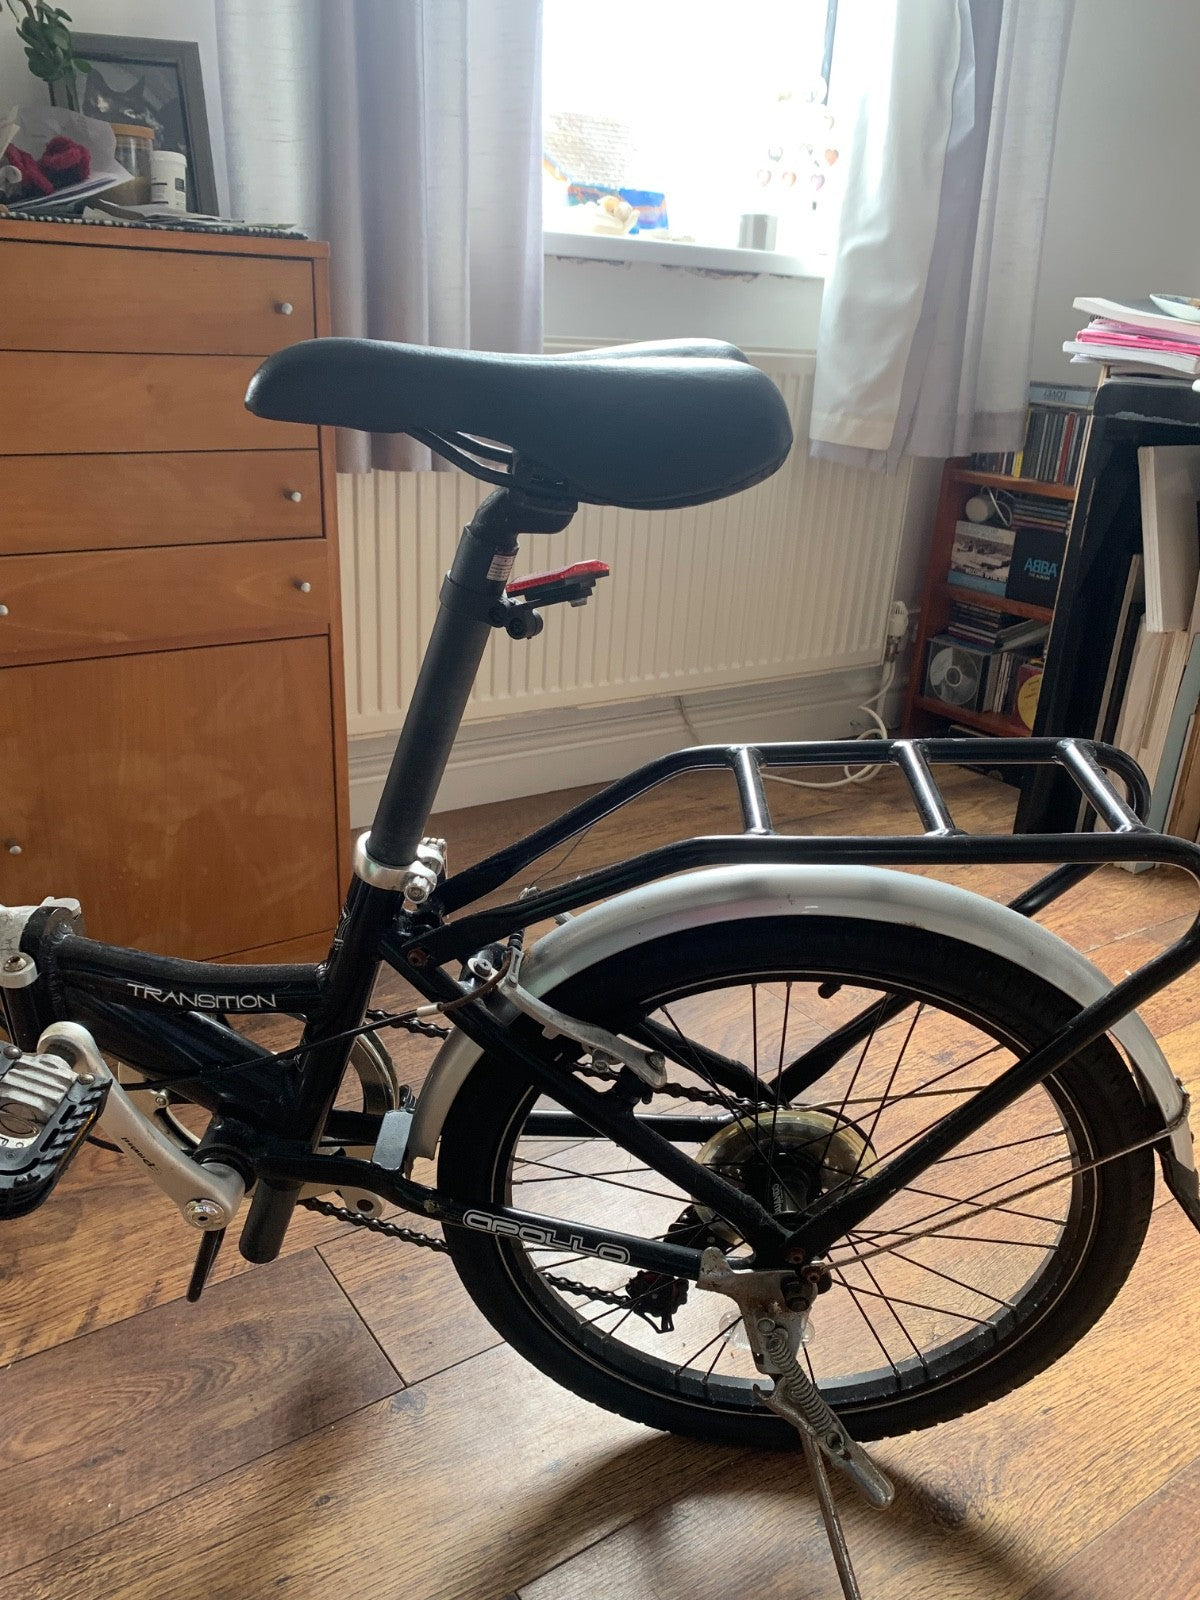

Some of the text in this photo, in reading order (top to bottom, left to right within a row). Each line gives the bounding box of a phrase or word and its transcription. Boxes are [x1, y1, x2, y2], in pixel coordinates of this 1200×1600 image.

[1024, 557, 1057, 578] ABBA
[127, 983, 277, 1009] TRANSITION
[463, 1209, 631, 1265] APOLLO
